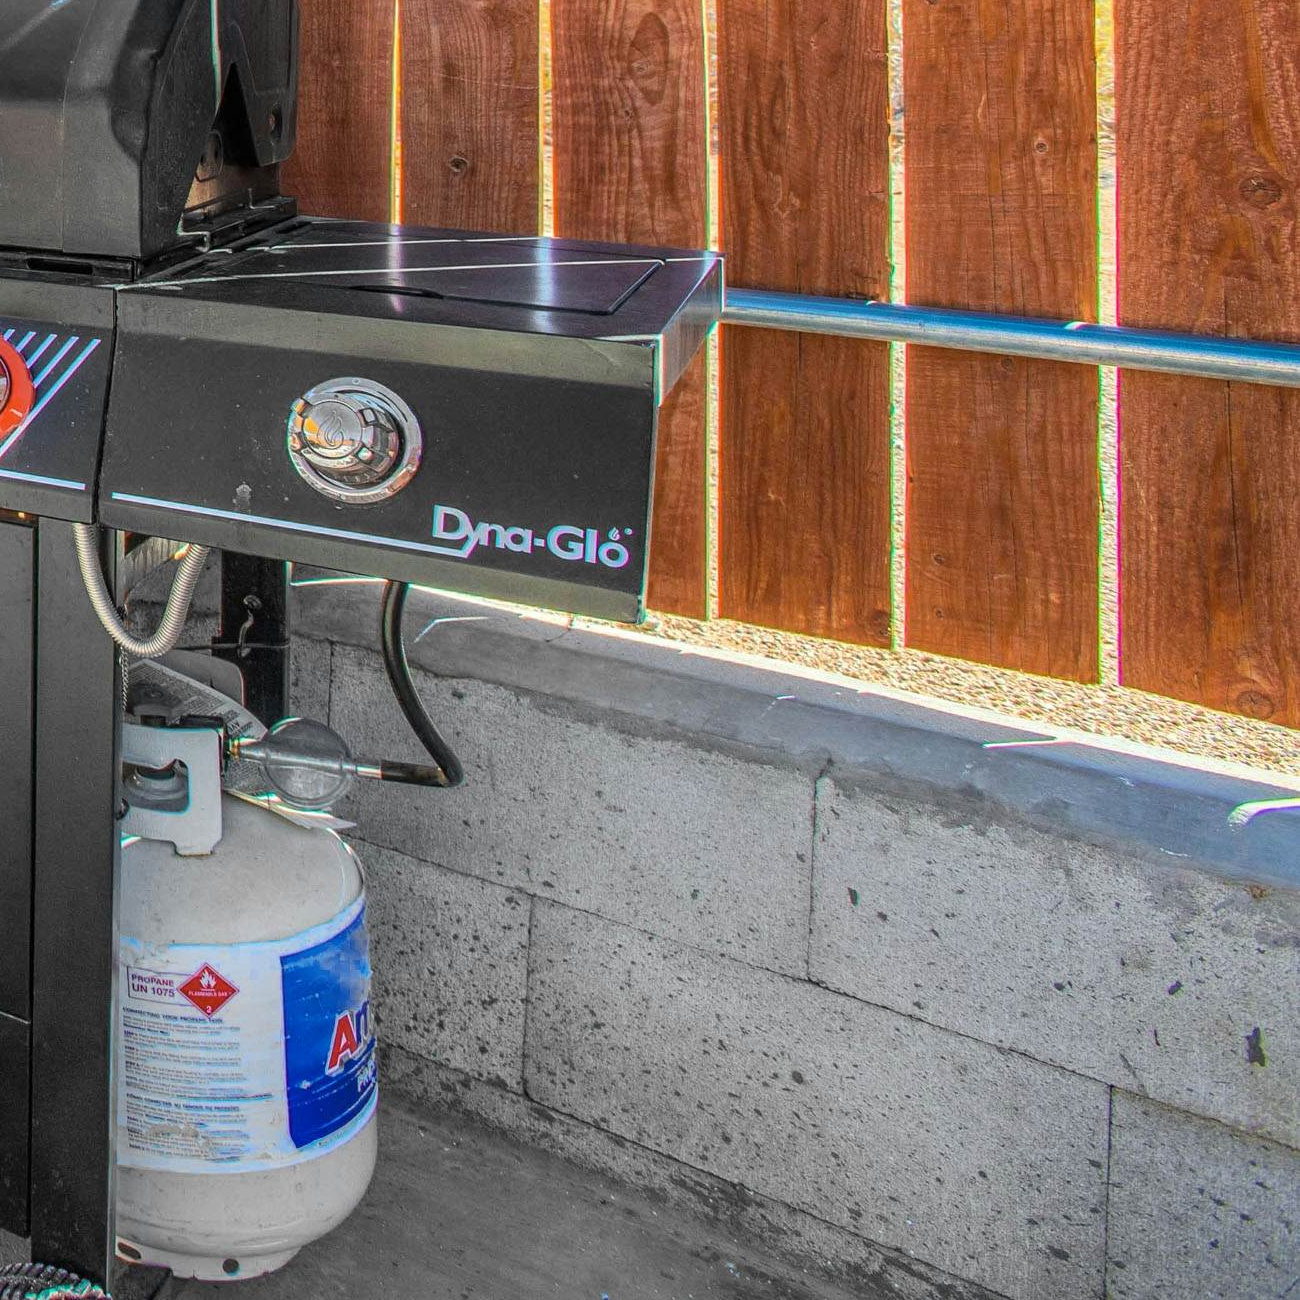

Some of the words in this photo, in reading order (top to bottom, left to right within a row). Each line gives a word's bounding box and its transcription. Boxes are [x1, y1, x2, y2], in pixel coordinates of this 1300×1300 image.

[432, 504, 630, 568] Dyna-Glo
[131, 973, 175, 987] PROPANE
[132, 983, 148, 994] UN
[151, 987, 175, 997] 1075
[206, 1005, 212, 1013] 2
